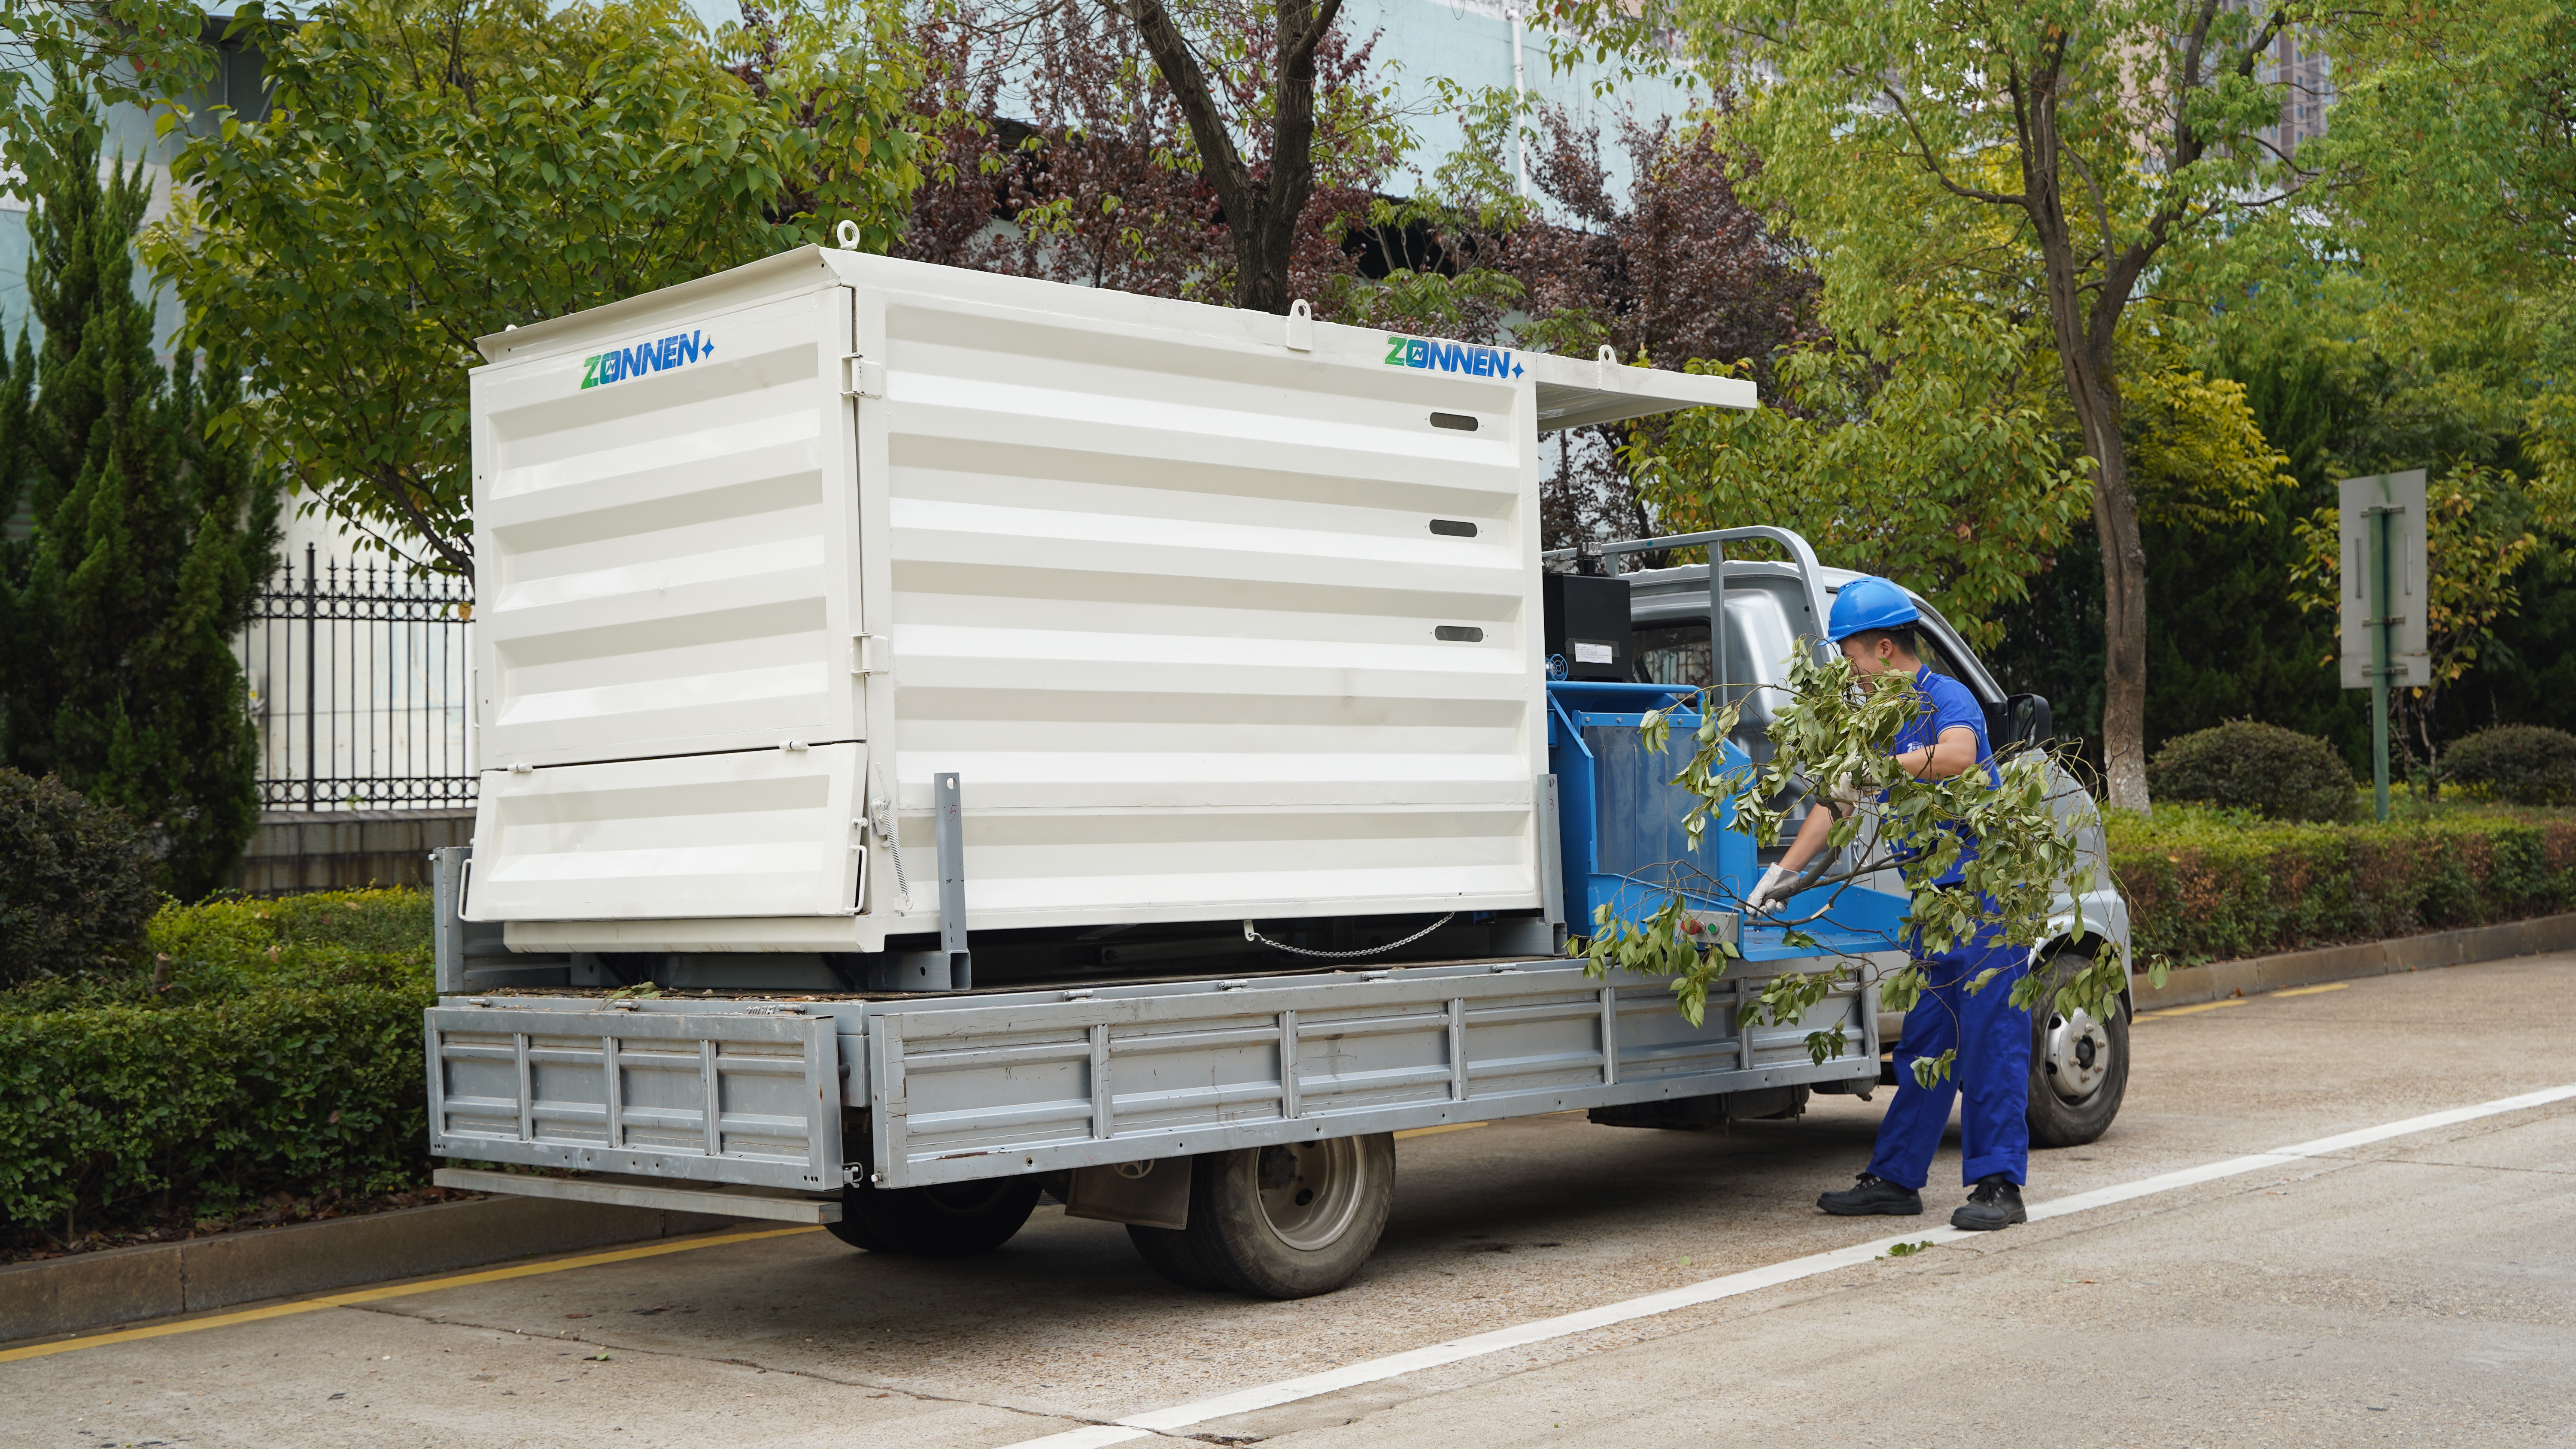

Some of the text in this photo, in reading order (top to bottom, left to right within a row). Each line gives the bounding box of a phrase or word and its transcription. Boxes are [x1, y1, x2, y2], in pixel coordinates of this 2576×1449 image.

[581, 329, 701, 390] ZONNEN
[1385, 336, 1510, 379] ZONNEN
[949, 800, 957, 822] 5
[1549, 799, 1554, 811] 3
